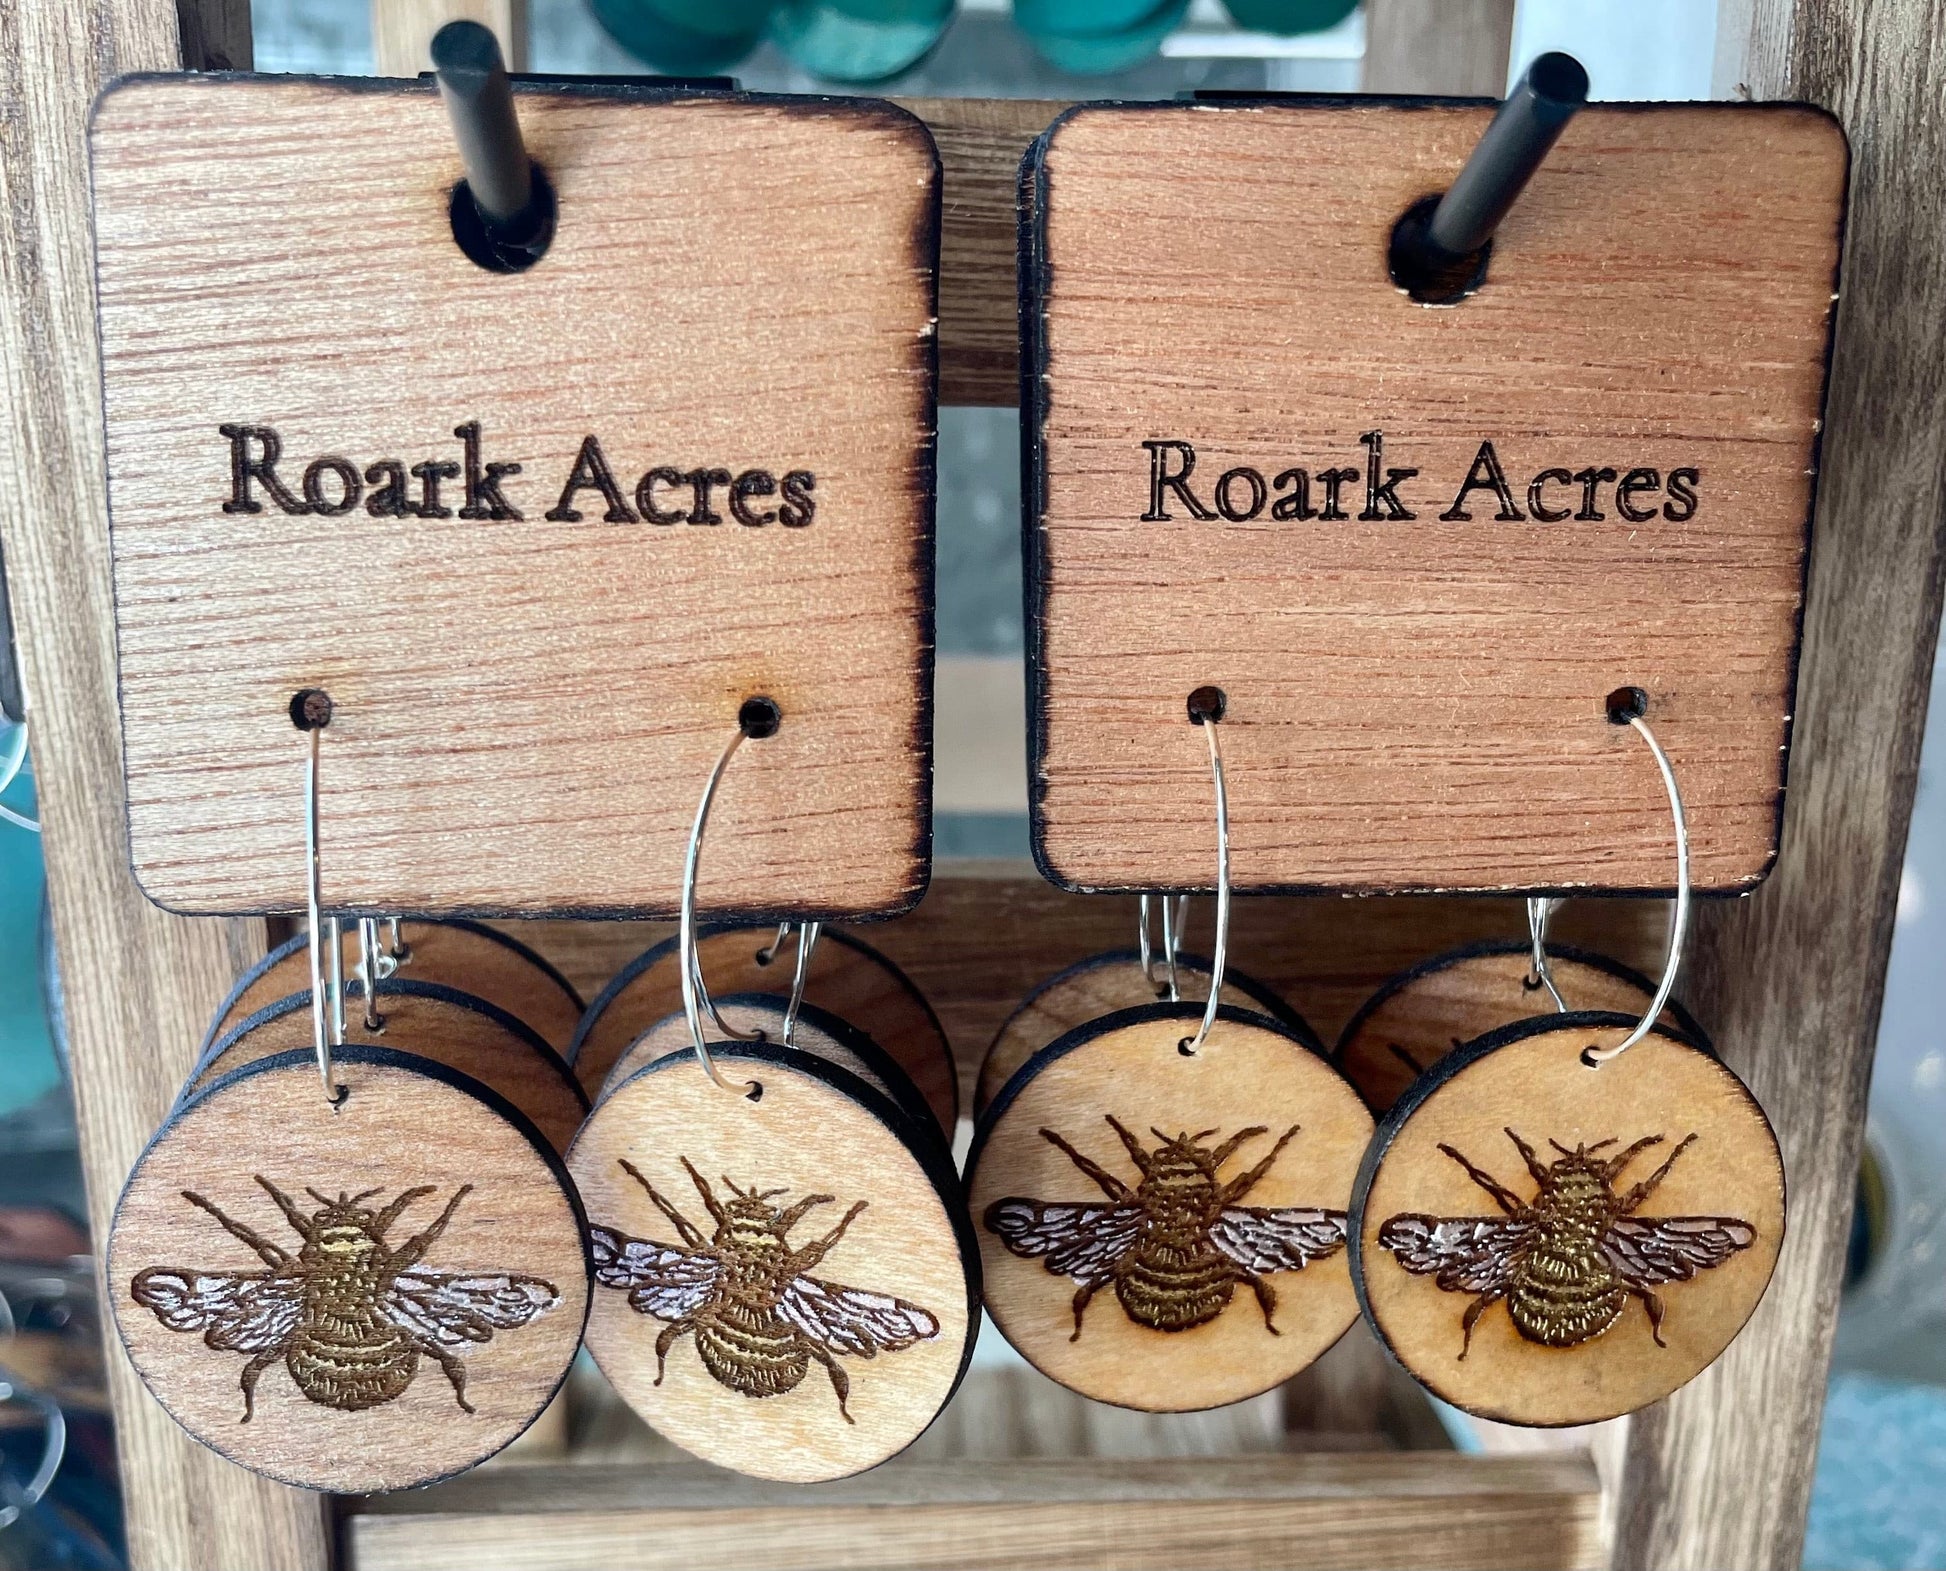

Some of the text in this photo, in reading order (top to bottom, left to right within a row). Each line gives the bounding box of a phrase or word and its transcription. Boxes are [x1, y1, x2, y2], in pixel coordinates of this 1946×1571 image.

[219, 420, 817, 528] Roark Acres
[1139, 428, 1701, 523] Roark Acres
